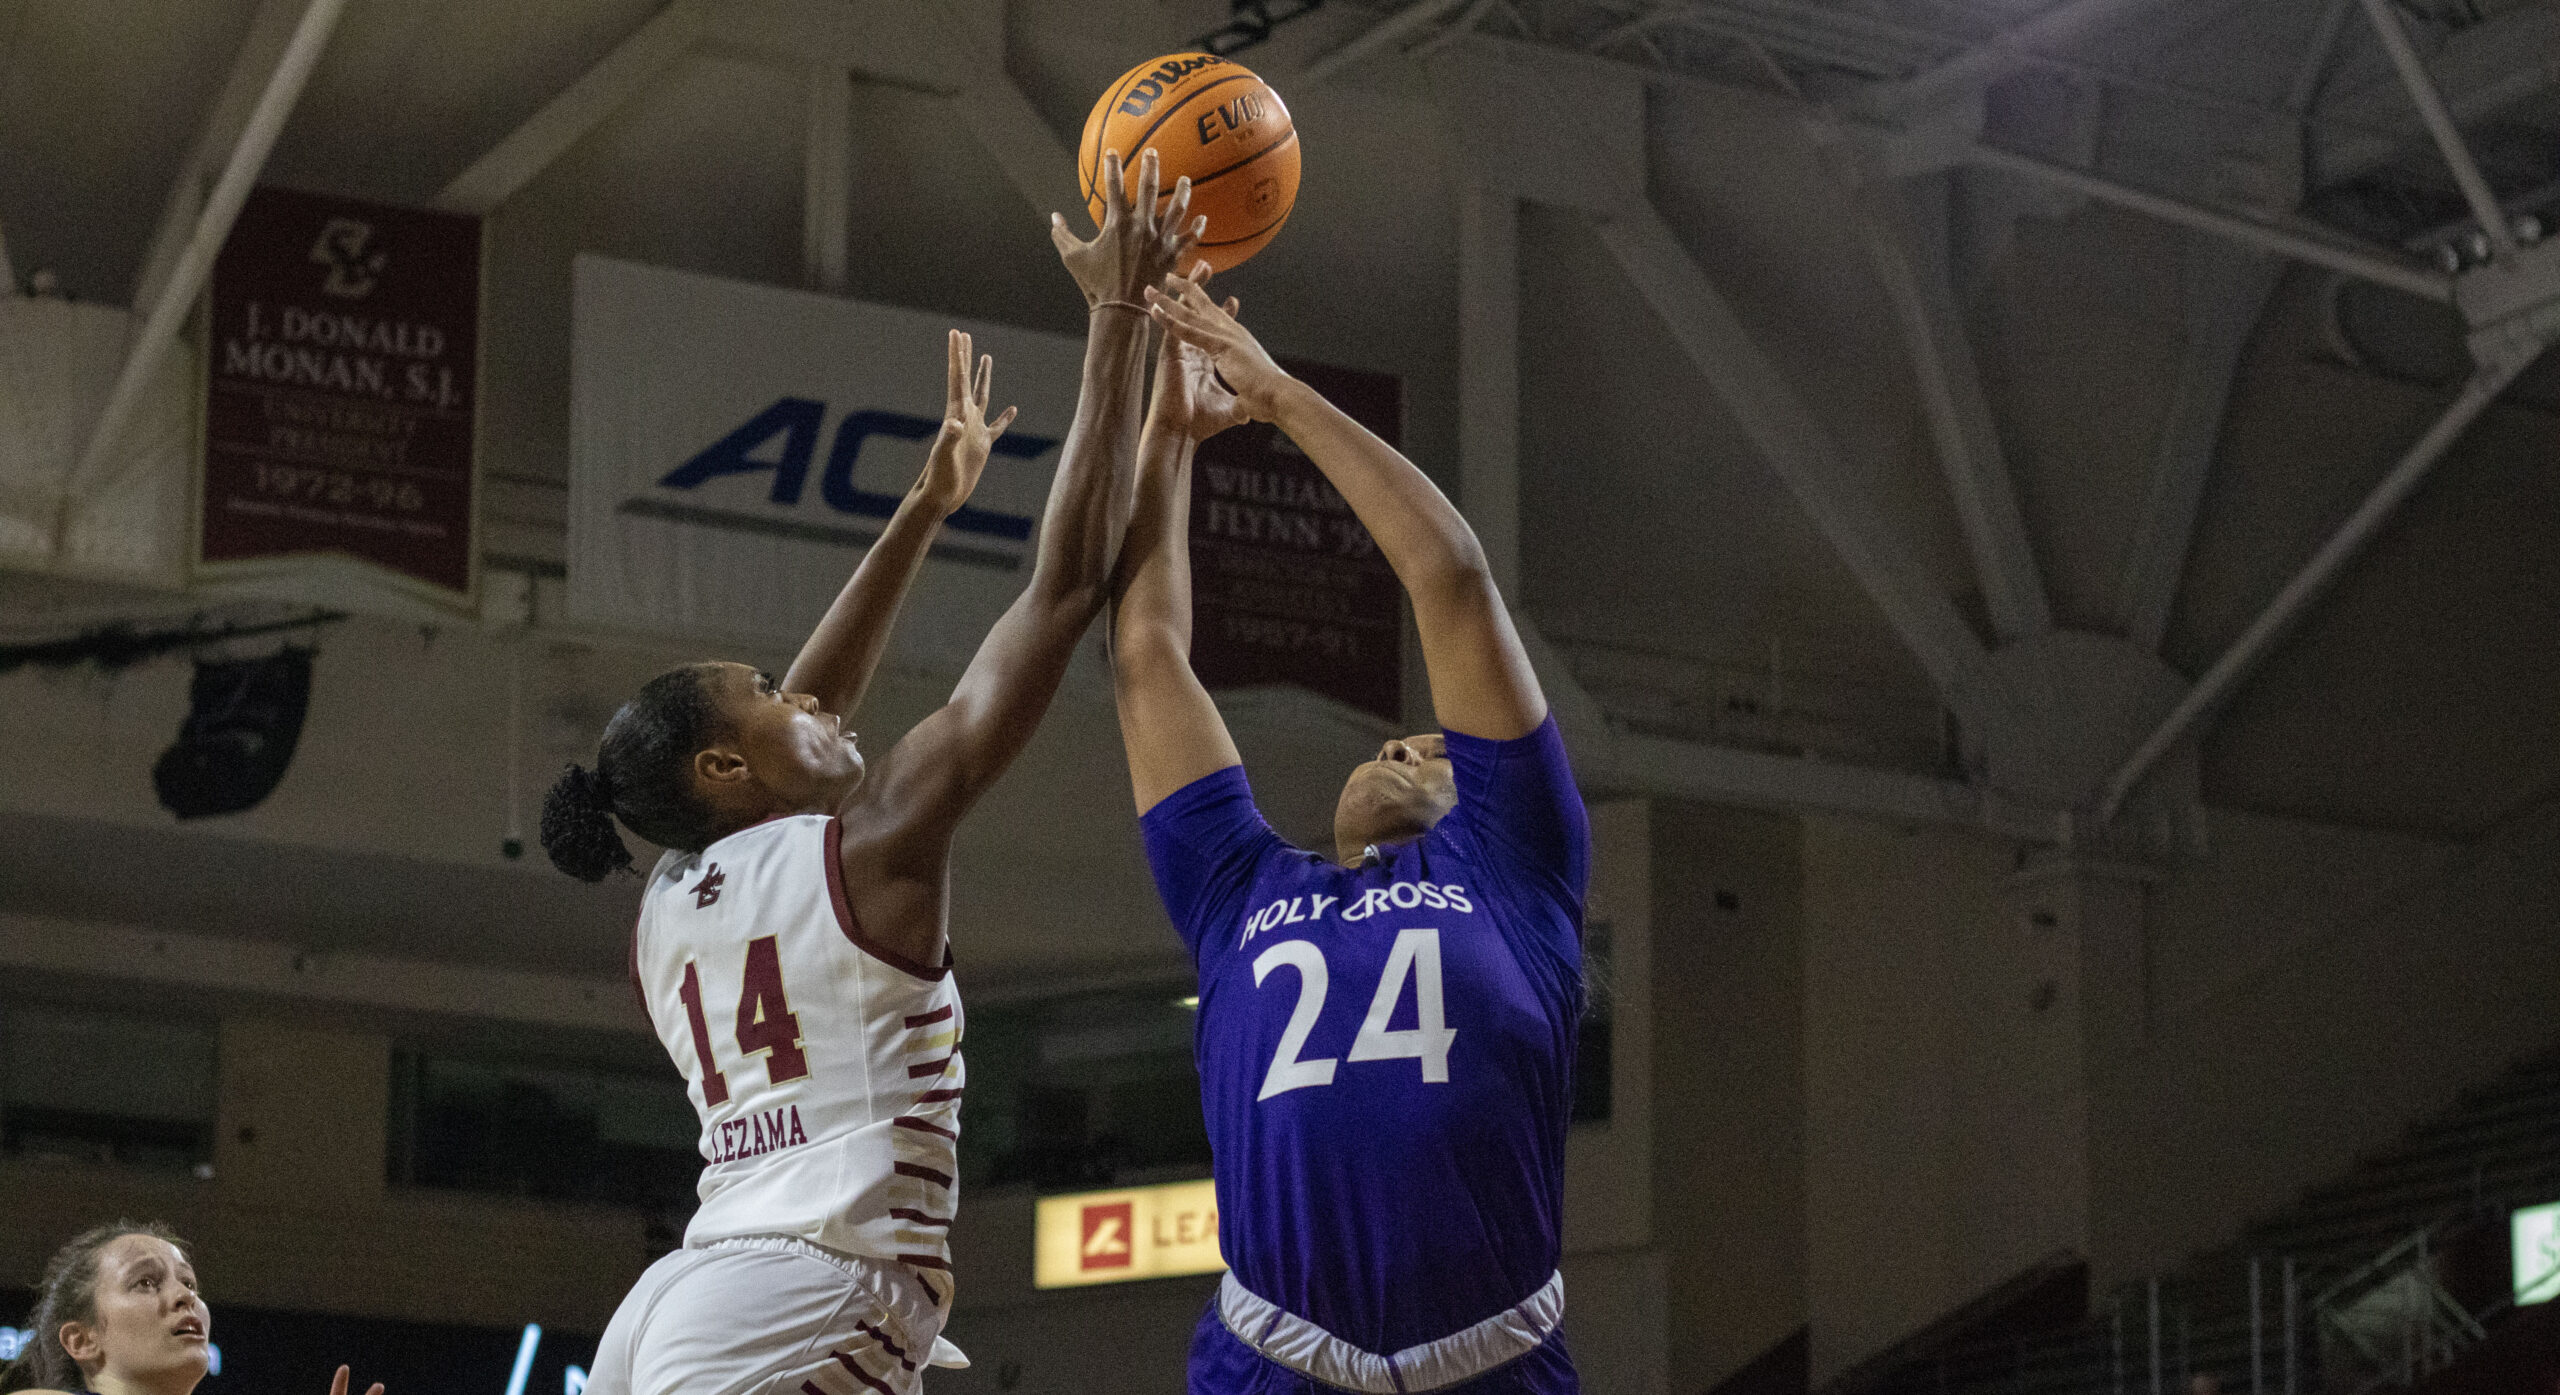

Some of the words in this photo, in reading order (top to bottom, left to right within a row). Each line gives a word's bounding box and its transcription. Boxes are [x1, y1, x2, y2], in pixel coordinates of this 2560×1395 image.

[283, 306, 445, 358] DONALD
[224, 338, 394, 398] MONAN,
[1207, 500, 1321, 547] FLYNN
[1239, 893, 1339, 951] HOLY
[1341, 880, 1473, 922] CROSS
[679, 933, 812, 1112] 14
[1252, 928, 1458, 1102] 24
[711, 1104, 808, 1165] LEZAMA
